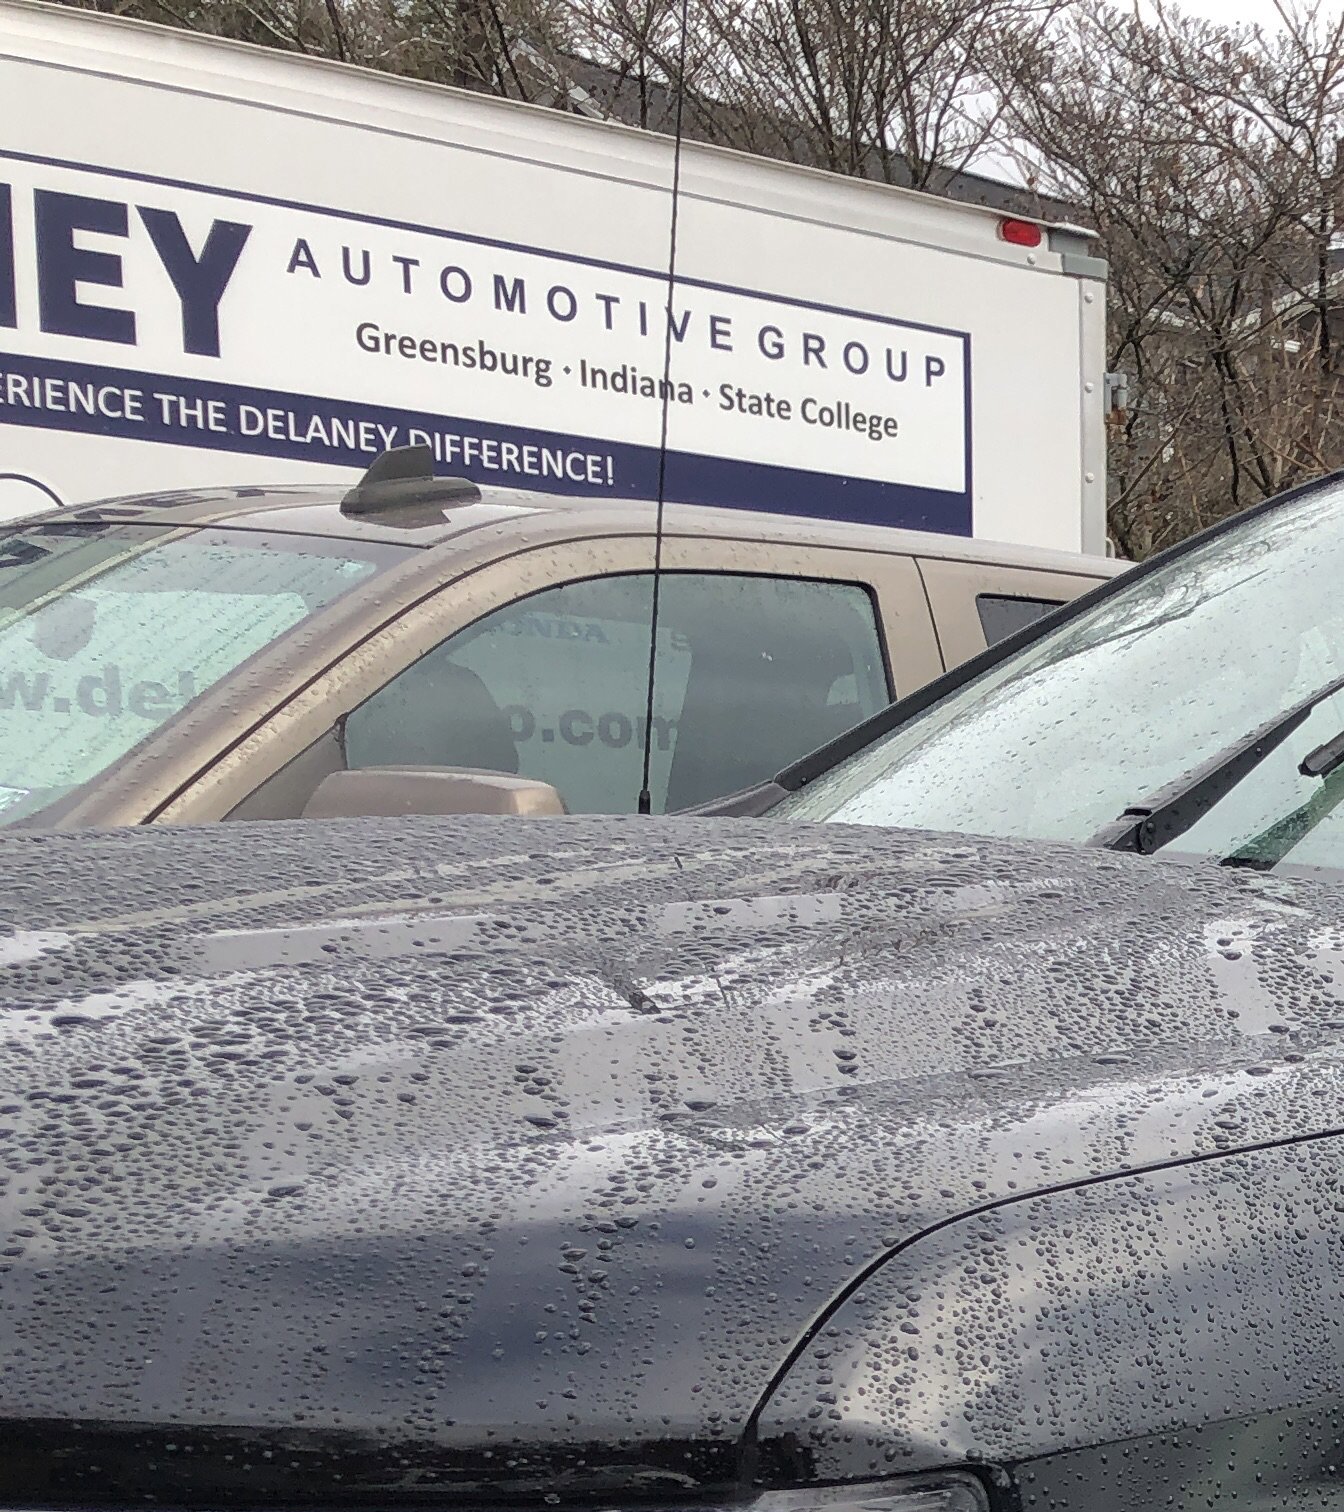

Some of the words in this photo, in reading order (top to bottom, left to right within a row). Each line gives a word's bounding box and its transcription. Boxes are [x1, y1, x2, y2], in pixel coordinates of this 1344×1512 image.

[286, 237, 733, 351] AUTOMOTIVE
[757, 325, 947, 388] GROUP
[0, 371, 144, 421] RIENCE
[153, 392, 226, 433] THE
[239, 405, 398, 453] DELANEY
[408, 428, 614, 487] DIFFERENCE!
[355, 321, 553, 388] Greensburg
[579, 357, 693, 404] Indiana
[719, 382, 792, 421] State
[799, 397, 900, 440] College
